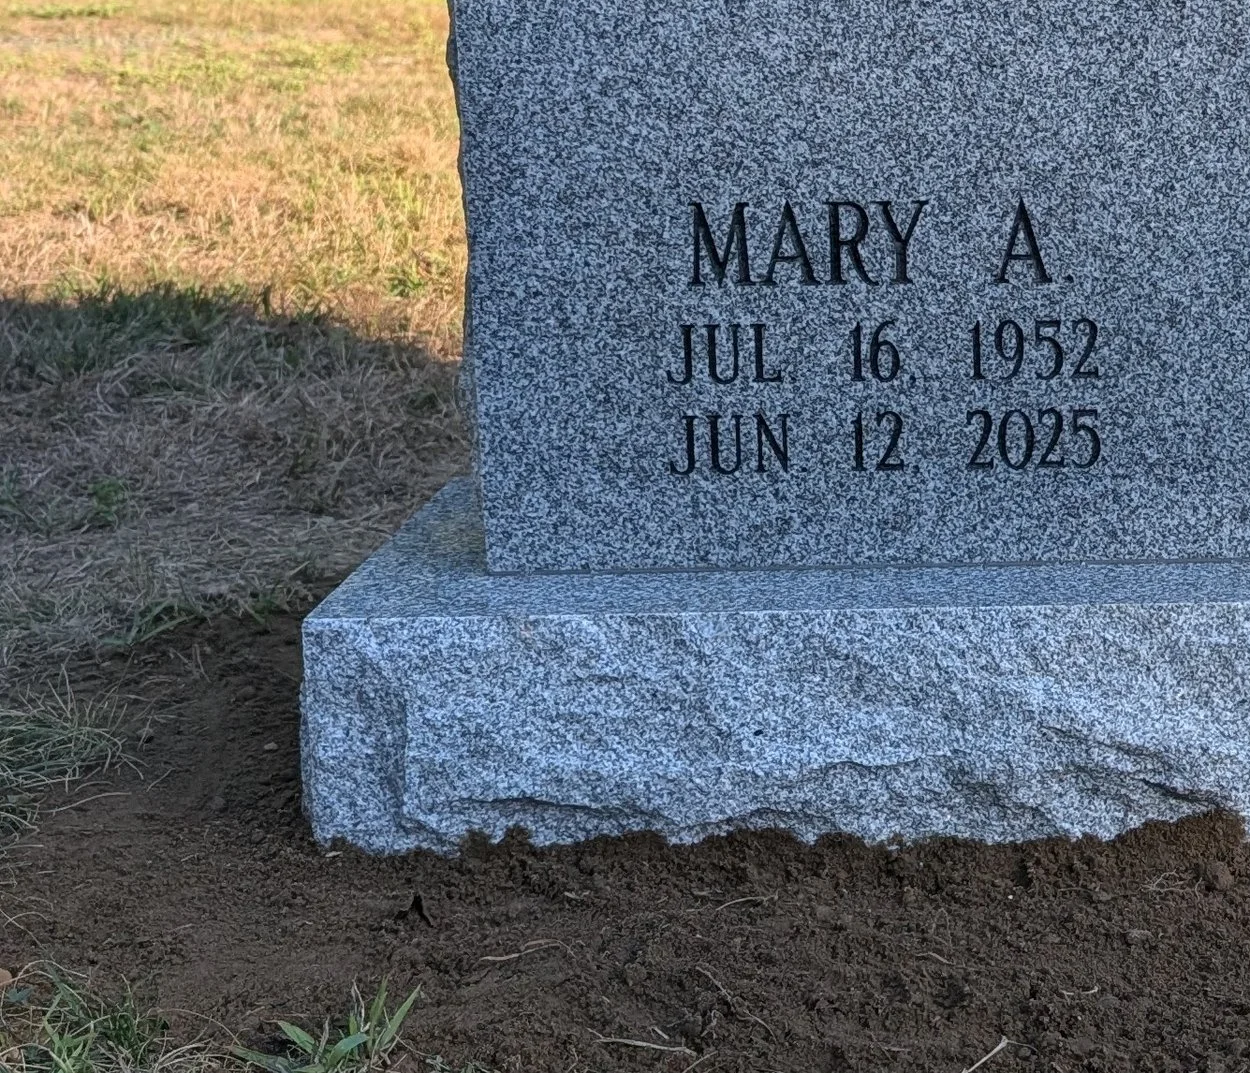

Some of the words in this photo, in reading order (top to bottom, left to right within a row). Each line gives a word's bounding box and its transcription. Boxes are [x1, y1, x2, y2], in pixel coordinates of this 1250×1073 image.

[688, 198, 929, 286] MARY
[997, 196, 1073, 285] A.
[970, 317, 1099, 381] 1952
[966, 406, 1101, 471] 2025
